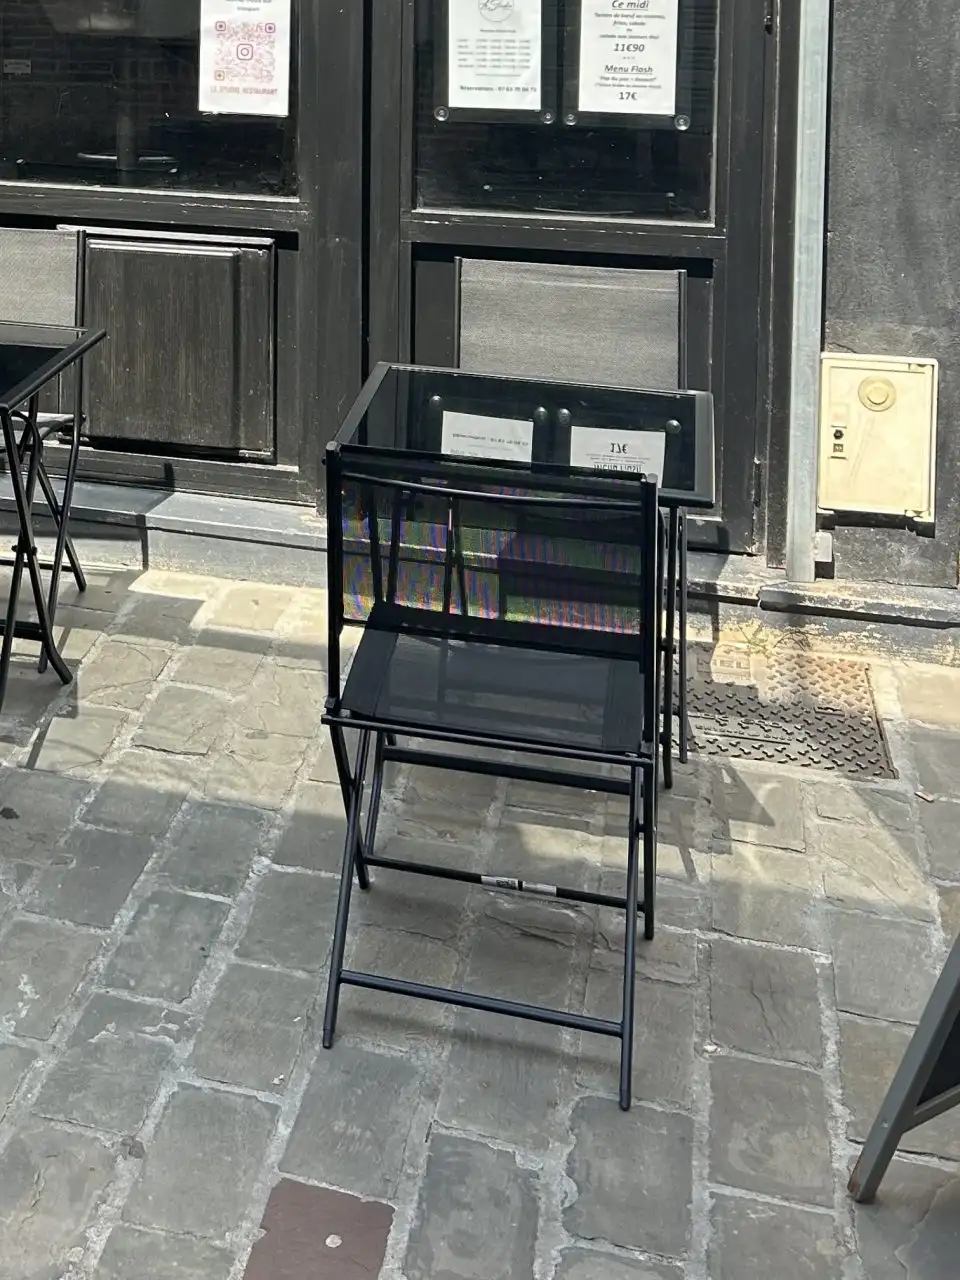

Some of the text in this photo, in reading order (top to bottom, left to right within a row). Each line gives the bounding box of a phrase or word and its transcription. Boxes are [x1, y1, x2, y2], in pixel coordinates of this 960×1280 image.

[611, 0, 650, 9] Ce midi
[613, 43, 646, 52] 11€90
[604, 64, 654, 74] Menu Flash
[618, 91, 638, 101] 17€
